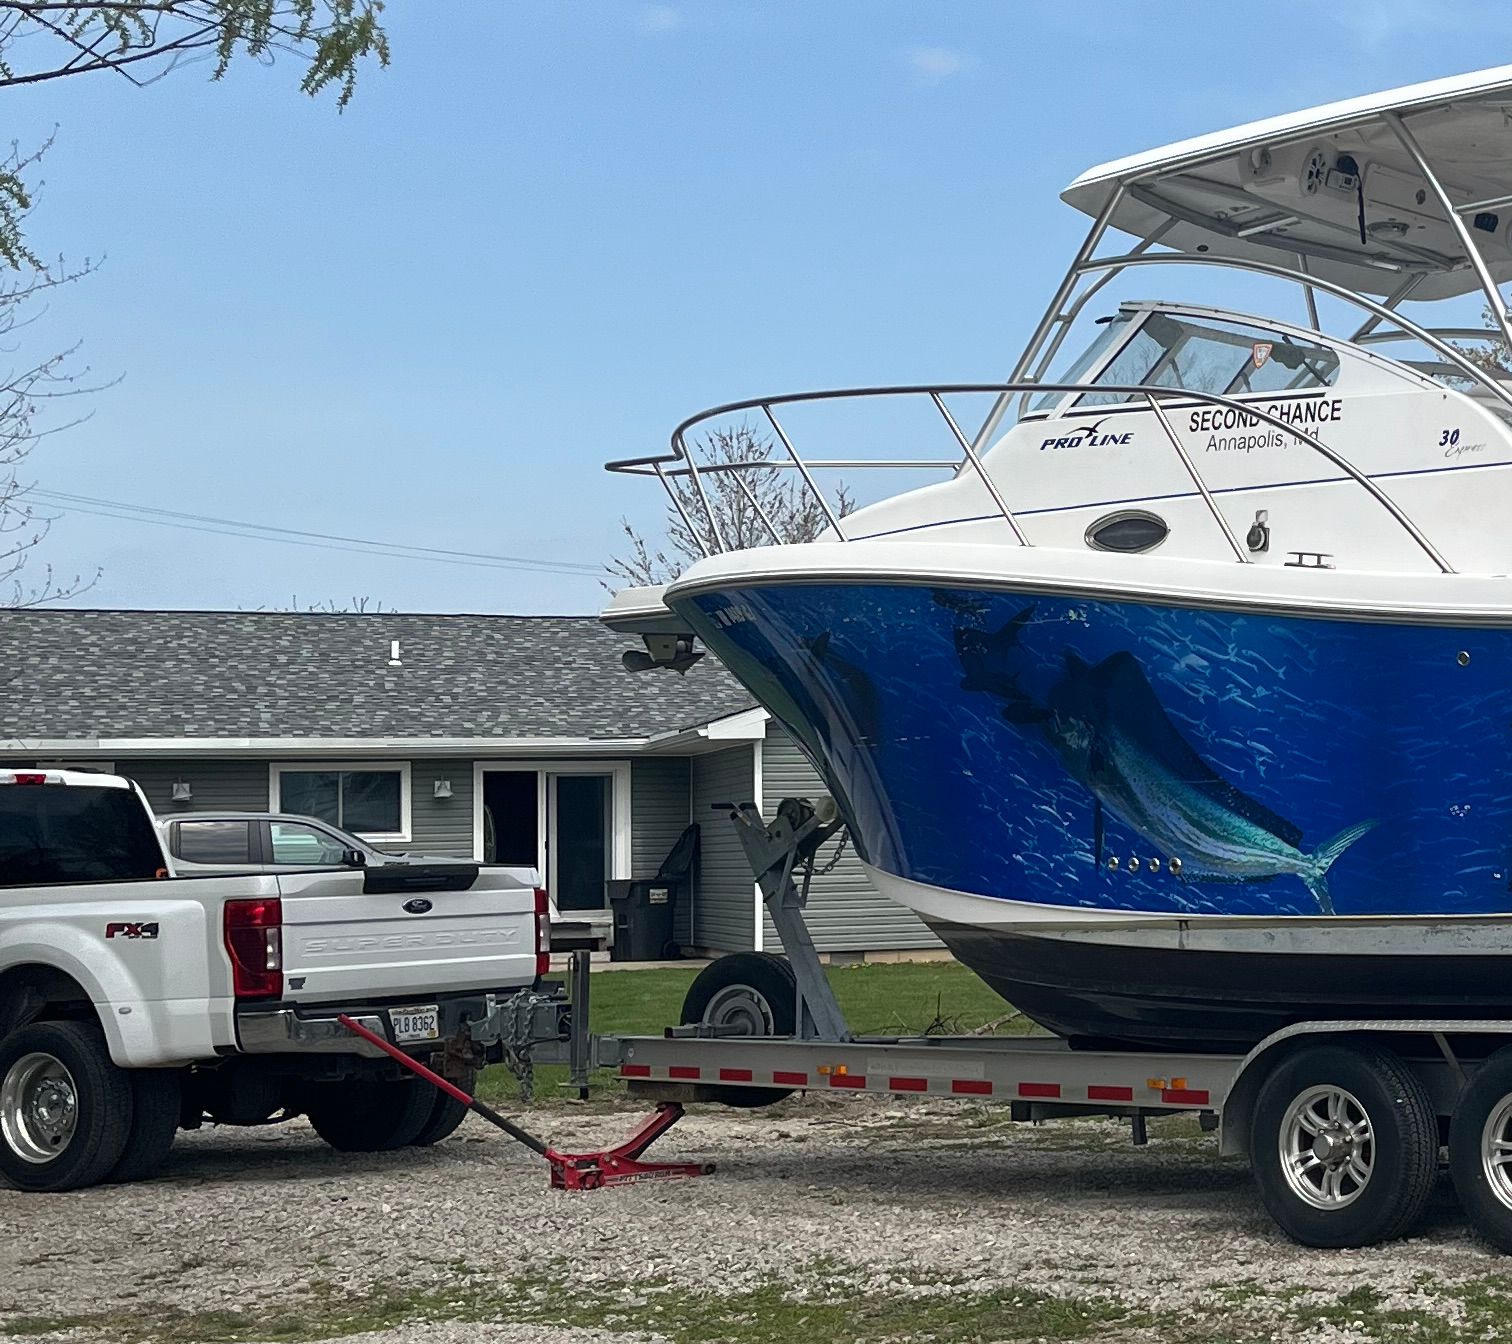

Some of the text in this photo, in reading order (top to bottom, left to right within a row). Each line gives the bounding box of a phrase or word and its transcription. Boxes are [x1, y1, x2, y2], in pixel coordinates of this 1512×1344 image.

[1188, 399, 1344, 433] SECOND CHANCE
[1205, 429, 1289, 454] Annapolis,
[1438, 428, 1460, 447] 30
[105, 922, 160, 940] FX4
[304, 928, 518, 954] SUPER DUTY
